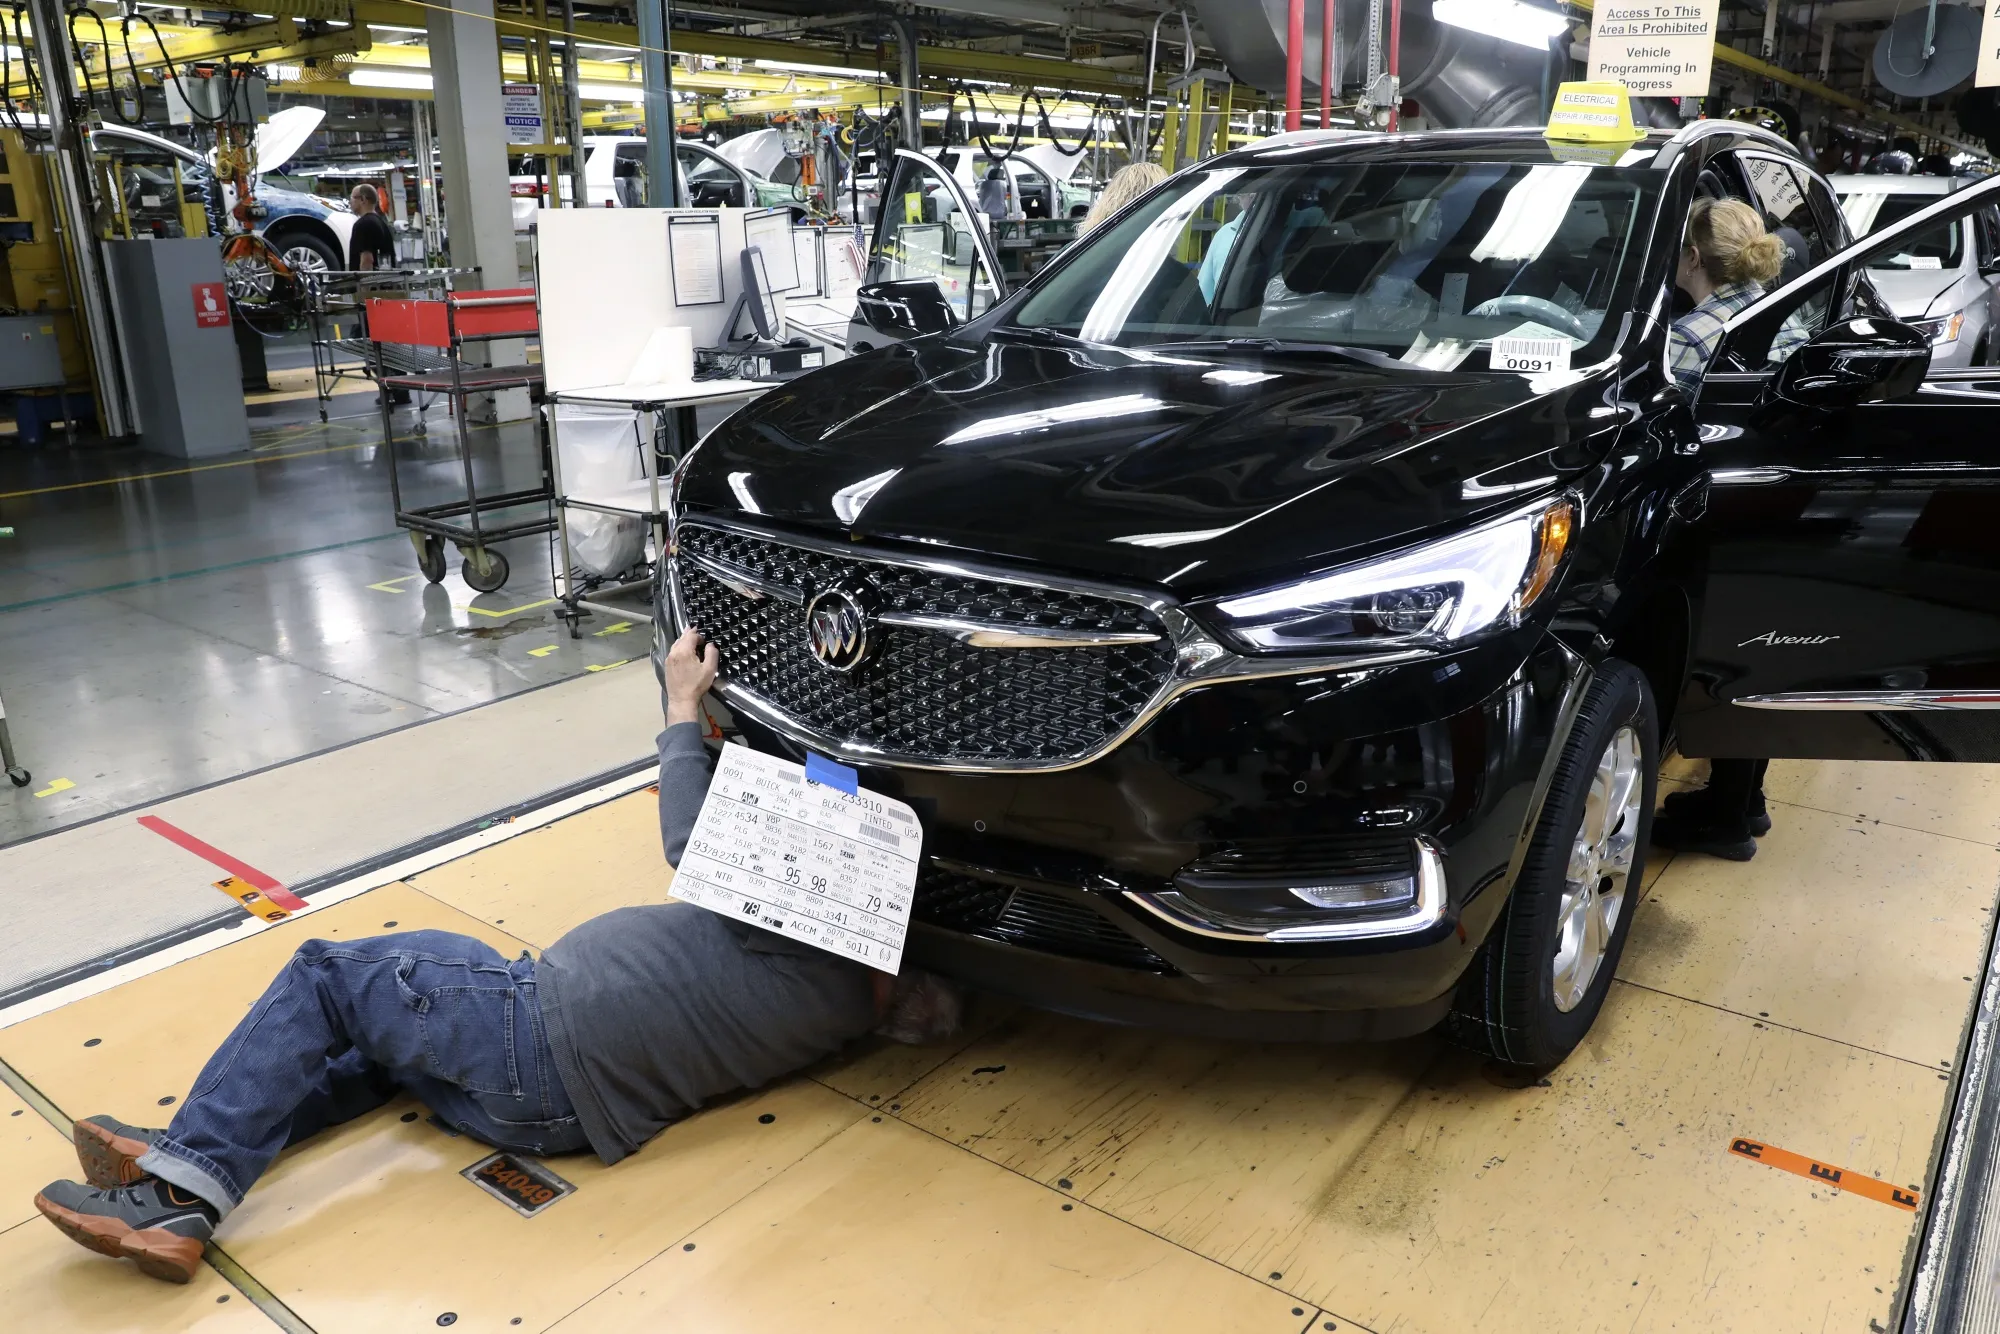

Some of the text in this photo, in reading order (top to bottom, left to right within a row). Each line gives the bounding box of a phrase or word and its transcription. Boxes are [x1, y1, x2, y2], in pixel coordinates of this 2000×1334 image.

[1606, 6, 1701, 19] Access To This
[1598, 22, 1708, 35] Area Is Prohibited
[1626, 47, 1671, 58] Vehicle
[1599, 62, 1697, 75] Programming In
[1563, 94, 1616, 105] ELECTRICAL
[508, 117, 538, 125] NOTICE
[1552, 111, 1579, 120] REPAIR
[1583, 113, 1618, 123] RE-FLASH
[1507, 358, 1552, 372] 0091
[1737, 630, 1841, 647] Avenir
[722, 785, 729, 793] 6
[716, 799, 736, 809] 2027
[723, 766, 920, 840] 0091 BUICK AVE BLACK TINTED USA
[841, 793, 882, 814] 233310
[713, 807, 733, 818] 1227
[734, 811, 758, 825] 4534
[766, 813, 781, 824] V8P
[705, 828, 725, 840] 9582
[733, 824, 748, 835] PLG
[734, 838, 753, 849] 1518
[761, 836, 780, 847] 8152
[813, 838, 834, 851] 1567
[692, 839, 719, 857] 9378
[759, 846, 777, 857] 9074
[789, 843, 807, 856] 9182
[718, 850, 745, 867] 2751
[815, 853, 833, 865] 4416
[842, 862, 860, 874] 4438
[689, 868, 710, 881] 7327
[714, 870, 733, 883] NTB
[784, 866, 801, 885] 95
[839, 873, 858, 885] 8357
[863, 869, 885, 881] BUCKET
[686, 879, 705, 891] 1303
[748, 876, 767, 888] 0391
[810, 875, 827, 894] 98
[682, 889, 701, 901] 7901
[713, 888, 733, 900] 0228
[777, 886, 797, 897] 2188
[773, 897, 793, 909] 2189
[805, 894, 824, 906] 8809
[865, 894, 882, 913] 79
[893, 893, 909, 905] 9581
[742, 901, 761, 917] 78
[802, 907, 821, 919] 7413
[824, 910, 849, 926] 3341
[859, 913, 878, 925] 2019
[790, 921, 817, 936] ACCM
[826, 927, 845, 939] 6070
[856, 926, 875, 938] 3409
[887, 923, 905, 936] 3974
[820, 936, 834, 947] AB4
[845, 940, 870, 957] 5011
[481, 1160, 554, 1205] 34049
